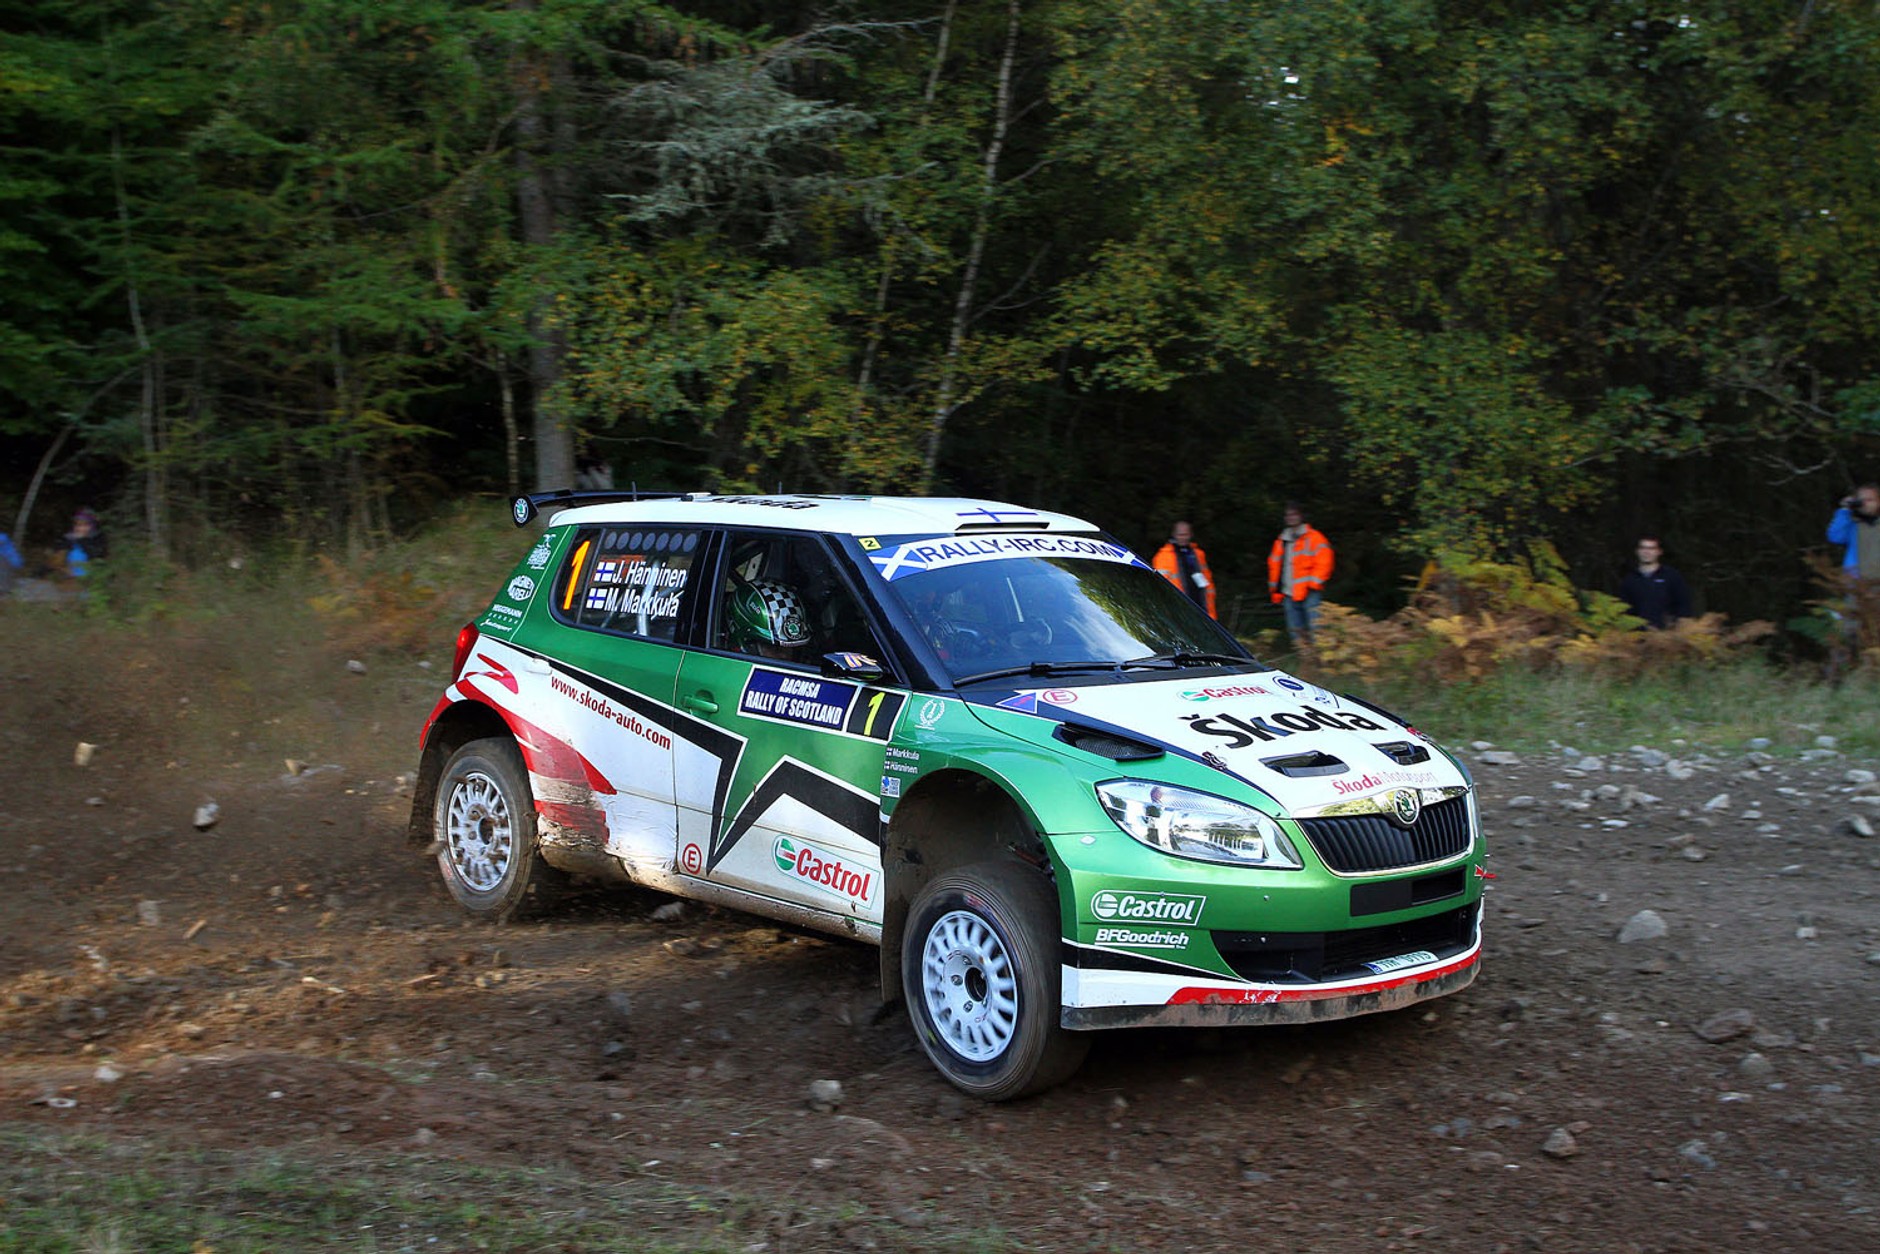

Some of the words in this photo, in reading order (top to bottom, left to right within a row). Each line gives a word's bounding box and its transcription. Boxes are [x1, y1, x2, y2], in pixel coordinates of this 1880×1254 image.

[917, 538, 1120, 563] RALLY-IRC.COM
[563, 541, 590, 610] 1
[612, 560, 623, 584] J.
[625, 561, 687, 588] Hänninen
[604, 588, 619, 611] M.
[621, 589, 680, 617] Markkula
[779, 677, 821, 699] RACMSA
[1203, 686, 1270, 699] Castrol
[551, 675, 671, 750] www.skoda-auto.com
[745, 690, 777, 712] RALLY
[774, 696, 790, 715] OF
[788, 698, 843, 725] SCOTLAND
[864, 691, 887, 737] 1
[1178, 705, 1387, 749] Škoda
[797, 848, 871, 901] Castrol
[1119, 896, 1196, 920] Castrol
[1096, 928, 1190, 945] BFGoodrich
